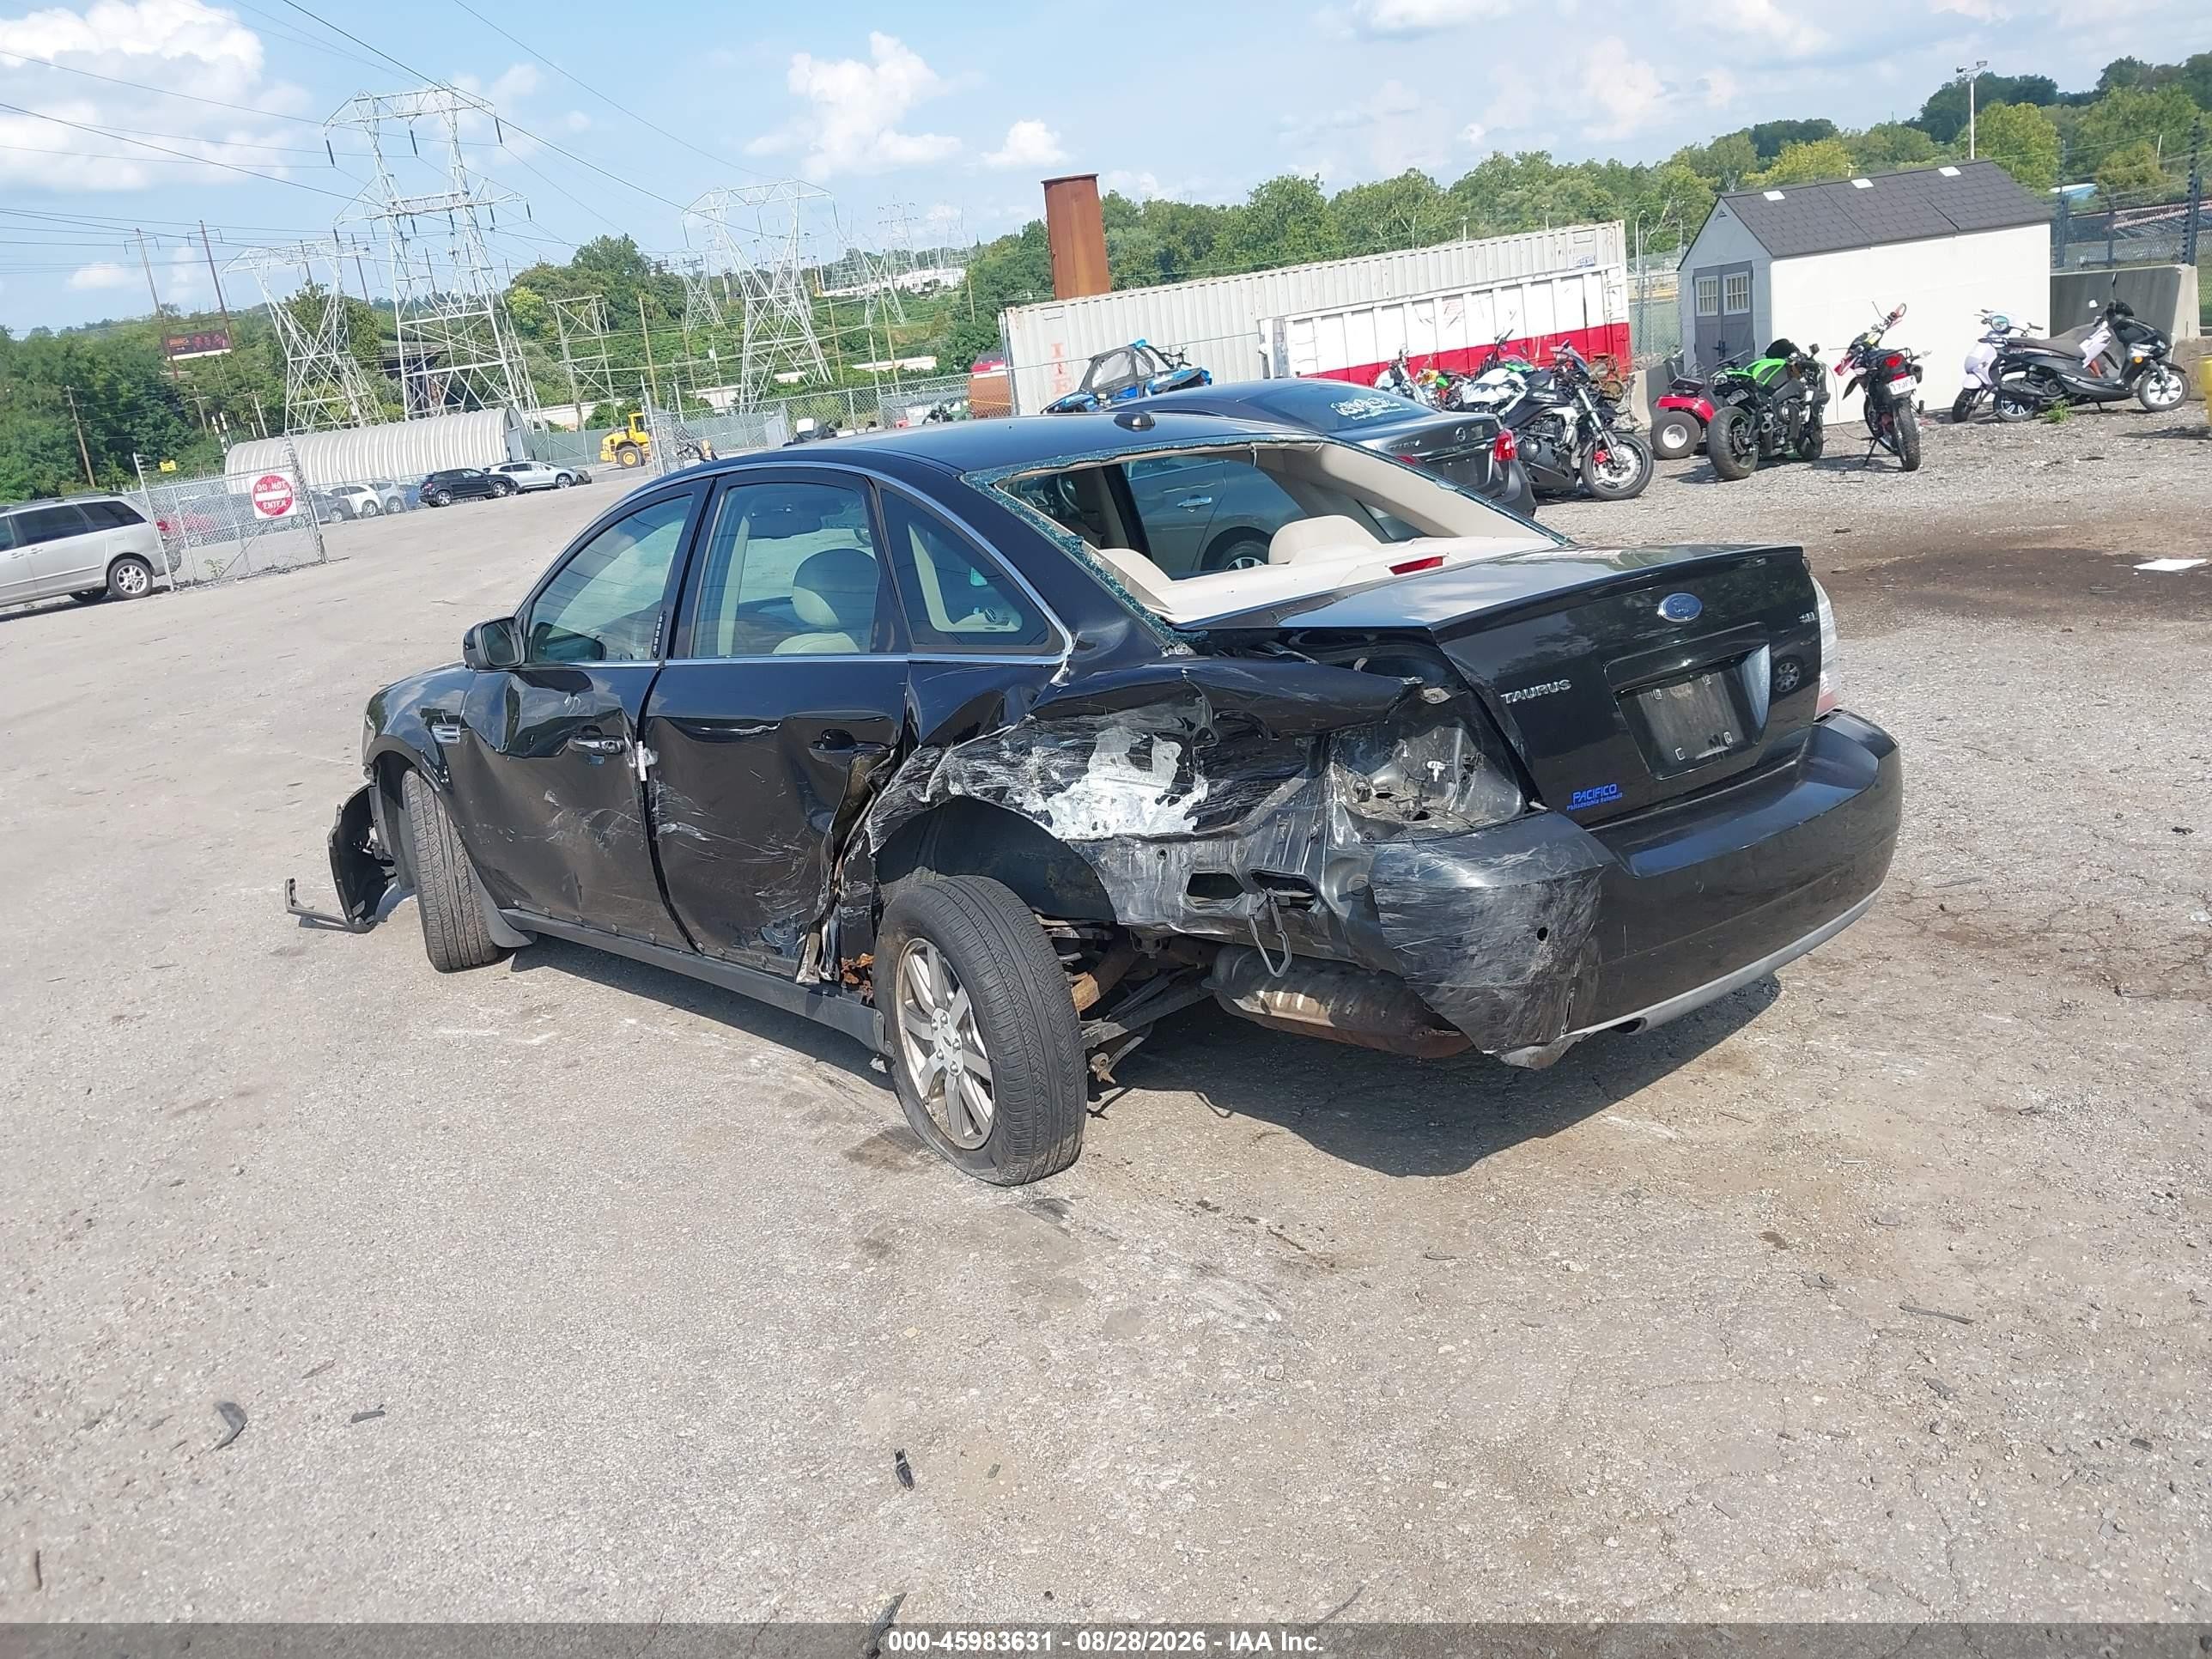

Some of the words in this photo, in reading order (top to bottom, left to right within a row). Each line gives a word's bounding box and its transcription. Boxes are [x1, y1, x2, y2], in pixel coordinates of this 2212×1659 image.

[271, 481, 289, 490] NOT
[263, 500, 287, 509] ENTER
[1500, 679, 1572, 704] TAURUS
[1572, 783, 1617, 805] PACIFICO
